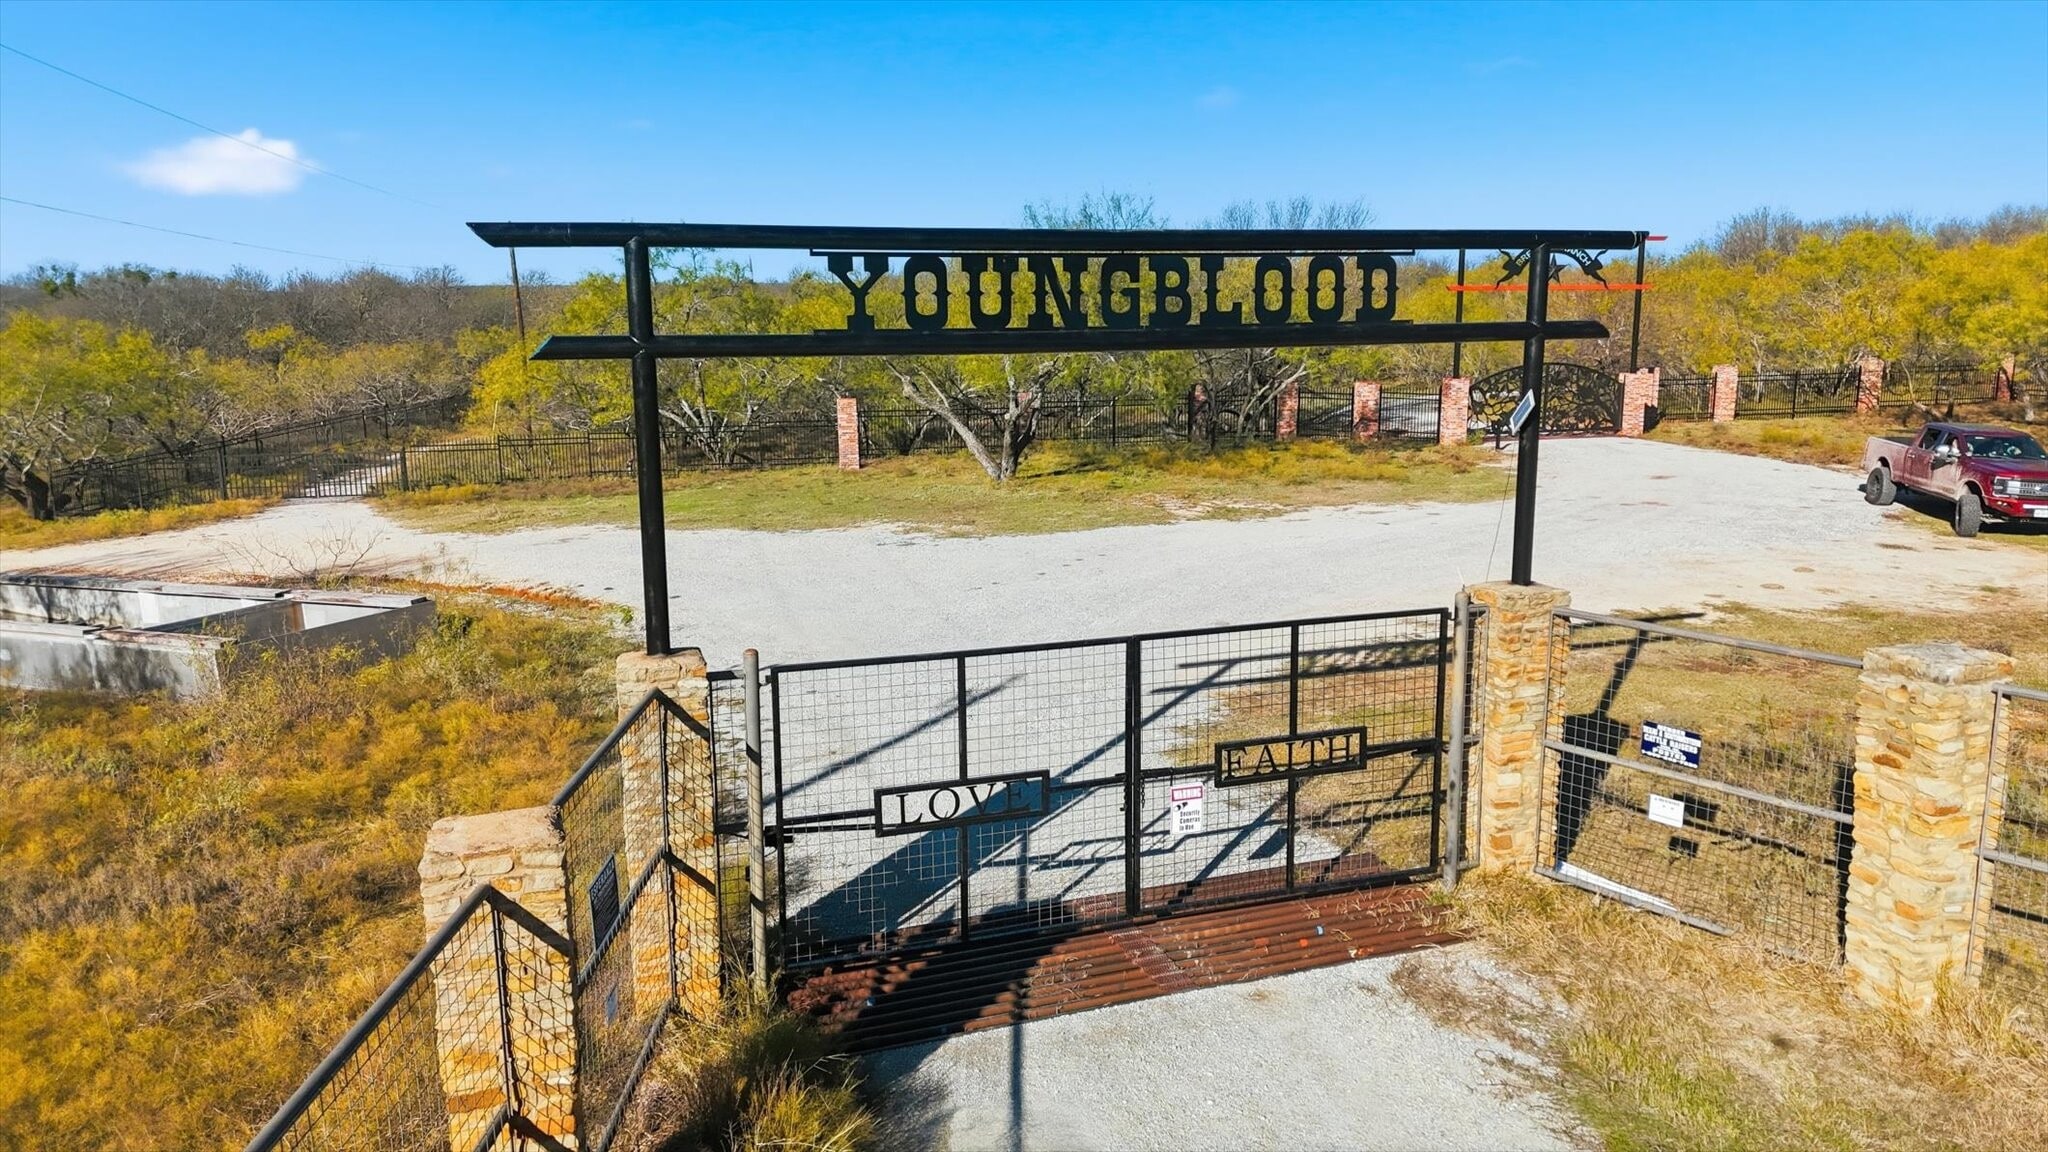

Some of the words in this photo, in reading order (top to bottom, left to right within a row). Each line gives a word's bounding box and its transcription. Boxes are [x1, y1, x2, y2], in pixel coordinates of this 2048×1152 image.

[828, 255, 1400, 330] YOUNGBLOOD
[1224, 735, 1353, 779] FAITH
[1652, 747, 1687, 761] POSTED
[896, 778, 1031, 828] LOVE
[1180, 810, 1200, 818] Security
